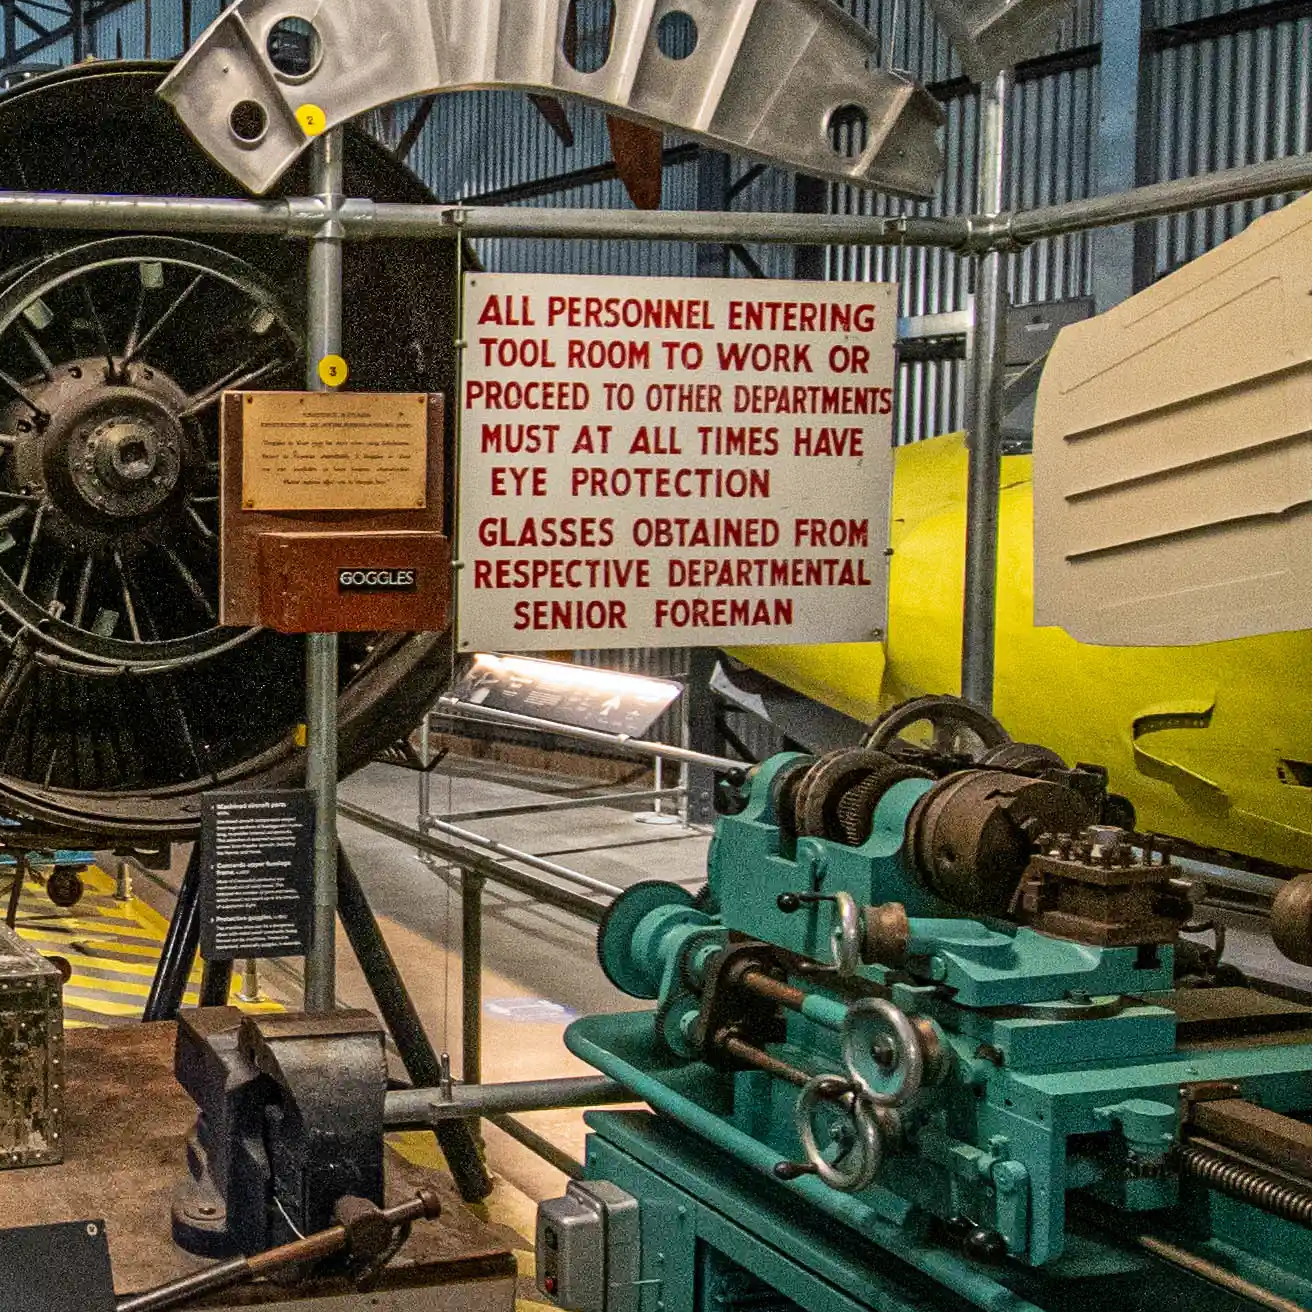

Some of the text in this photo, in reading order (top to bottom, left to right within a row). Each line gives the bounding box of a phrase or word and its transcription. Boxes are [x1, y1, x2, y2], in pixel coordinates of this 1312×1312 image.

[306, 116, 314, 125] 2
[479, 295, 875, 333] ALL PERSONNEL ENTERING
[329, 366, 337, 376] 3
[479, 338, 870, 375] TOOL ROOM TO WORK OR
[466, 380, 892, 414] PROCEED TO OTHER DEPARTMENTS
[481, 425, 864, 457] MUST AT ALL TIMES HAVE
[491, 467, 770, 498] EYE PROTECTION
[478, 517, 868, 548] GLASSES OBTAINED FROM
[339, 571, 414, 586] GOGGLES
[474, 559, 869, 589] RESPECTIVE DEPARTMENTAL
[515, 599, 794, 631] SENIOR FOREMAN
